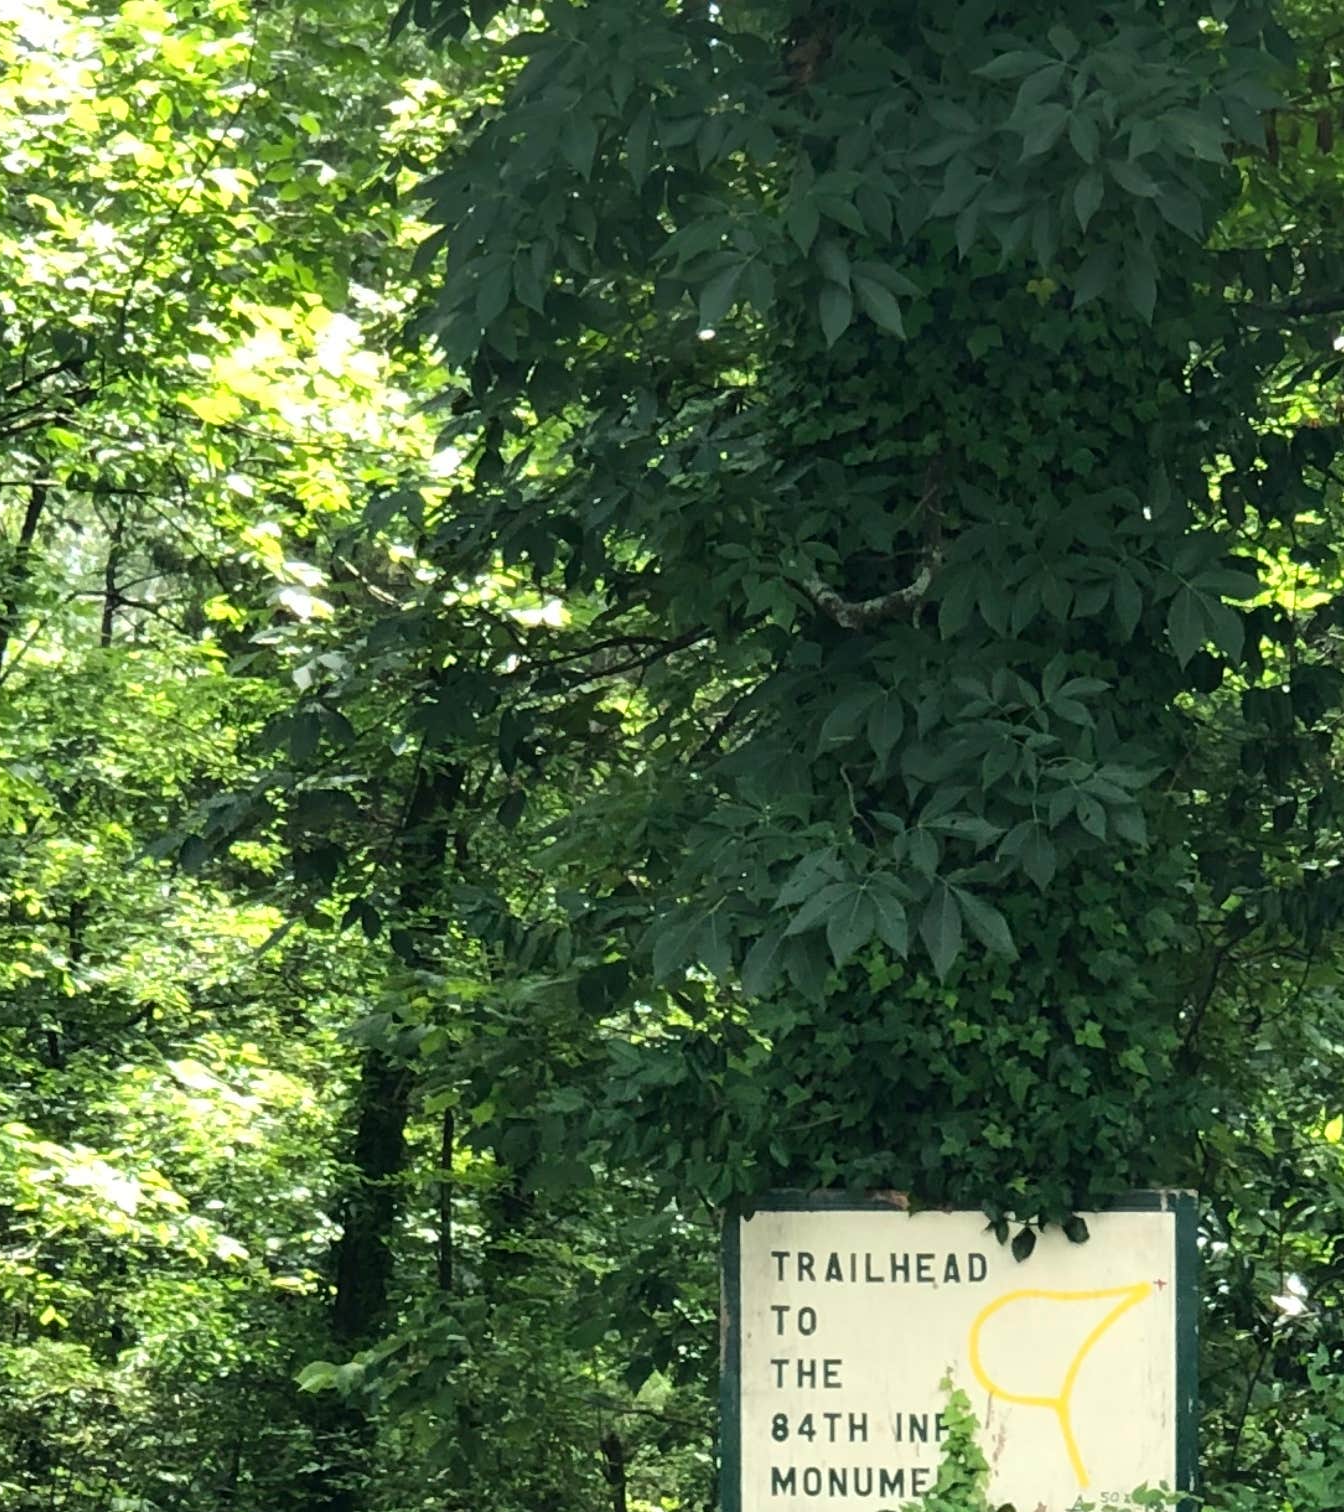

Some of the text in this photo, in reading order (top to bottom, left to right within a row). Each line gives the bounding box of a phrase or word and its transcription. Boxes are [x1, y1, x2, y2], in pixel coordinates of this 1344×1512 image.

[771, 1251, 989, 1283] TRAILHEAD
[771, 1305, 817, 1336] TO
[771, 1359, 842, 1389] THE
[771, 1412, 868, 1443] 84TH
[771, 1467, 931, 1499] MONUME
